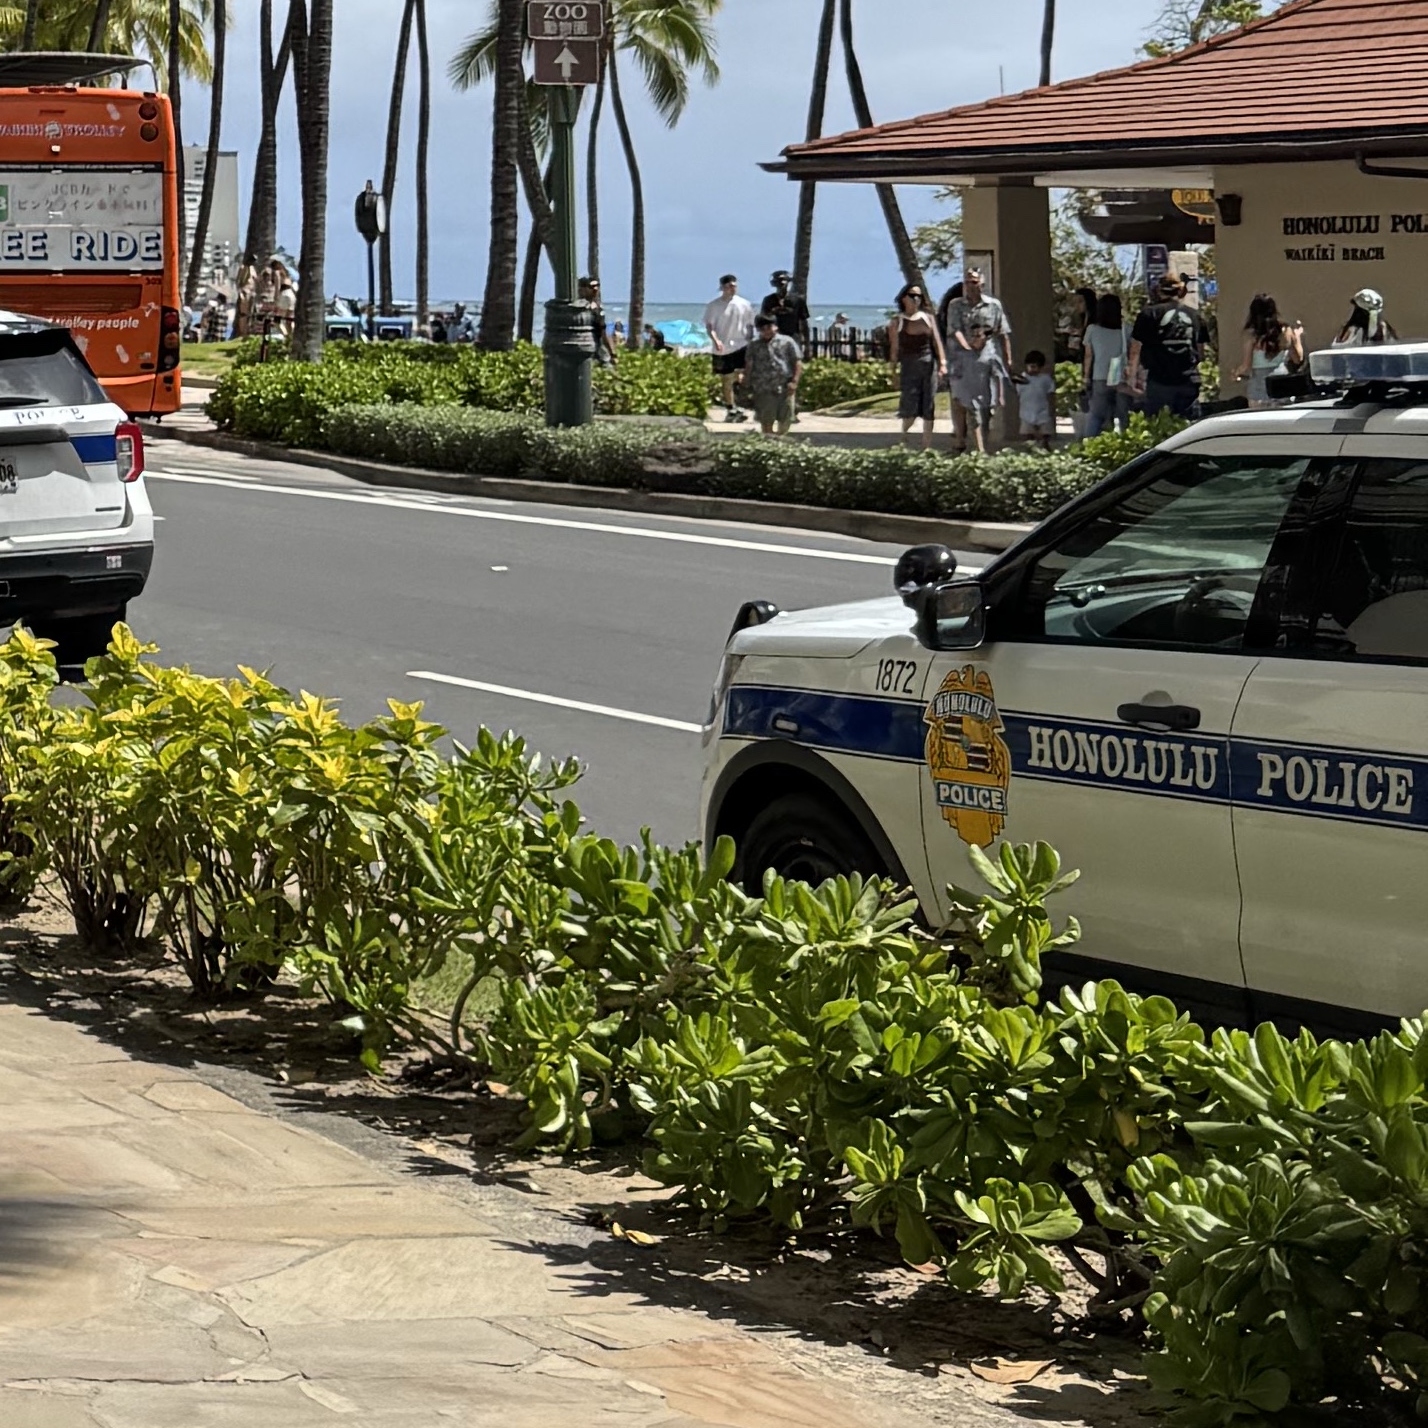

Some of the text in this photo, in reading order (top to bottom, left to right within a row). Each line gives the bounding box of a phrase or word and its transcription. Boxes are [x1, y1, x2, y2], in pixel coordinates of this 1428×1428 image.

[543, 4, 588, 20] ZOO
[1283, 215, 1380, 235] HONOLULU
[70, 230, 162, 261] RIDE
[1342, 247, 1385, 261] BEACH
[97, 317, 140, 330] people
[875, 658, 917, 694] 1872
[1028, 725, 1415, 815] HONOLULU POLICE
[939, 784, 1004, 811] POLICE
